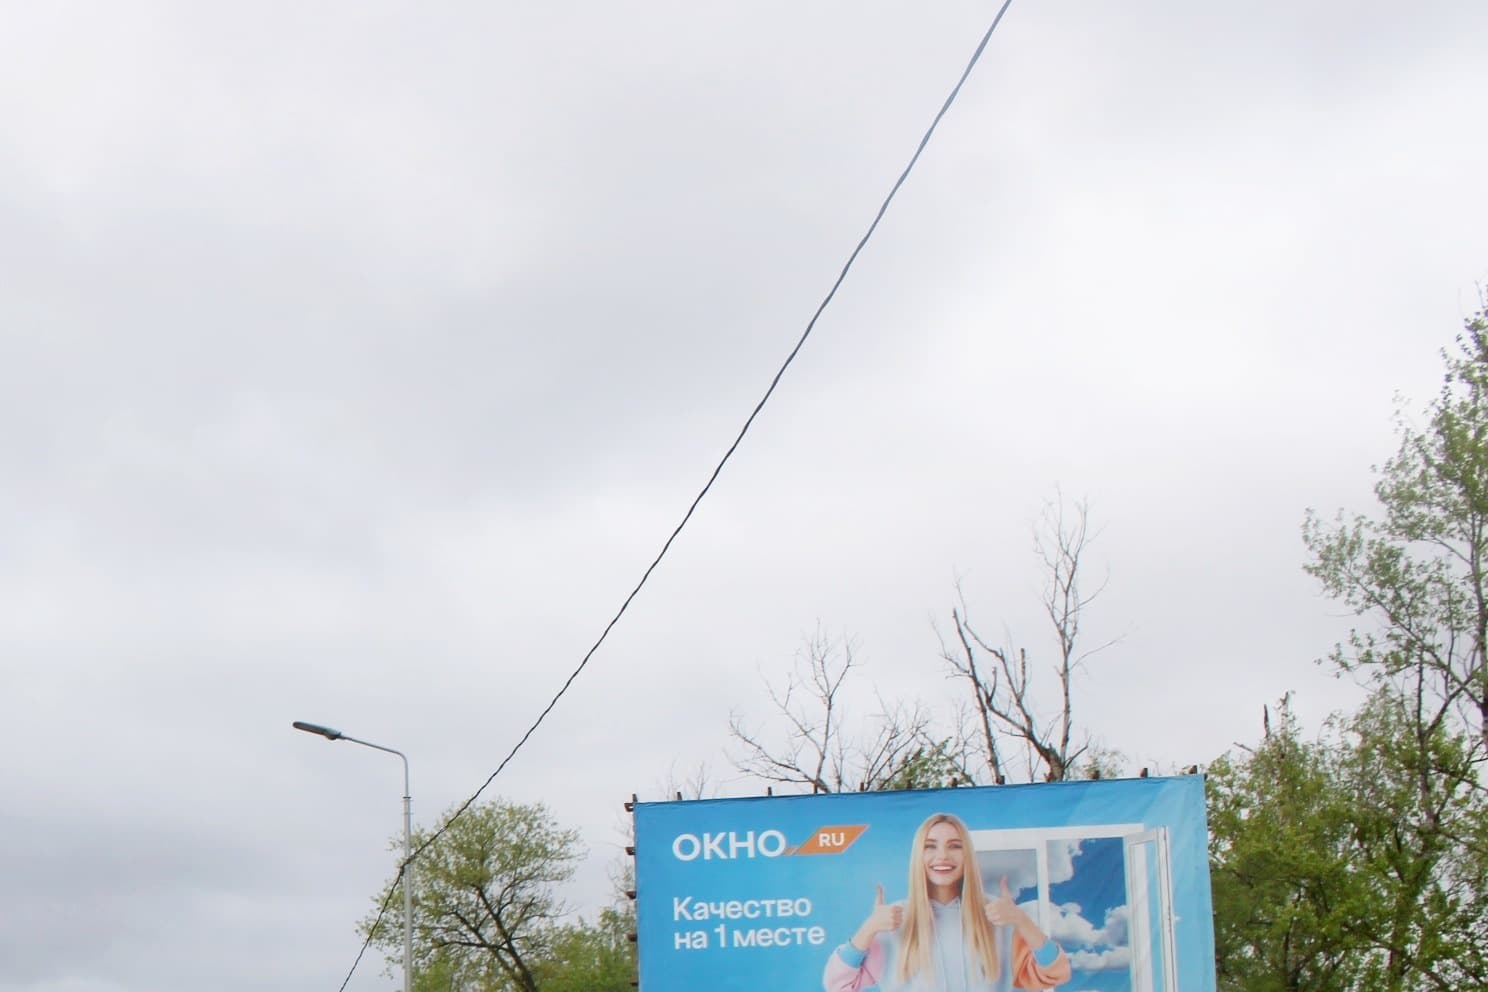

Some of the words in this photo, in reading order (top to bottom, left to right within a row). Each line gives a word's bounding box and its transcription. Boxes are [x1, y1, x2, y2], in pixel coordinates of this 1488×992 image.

[672, 829, 787, 862] ОКНО
[818, 832, 846, 848] RU
[673, 896, 813, 922] Качество
[674, 930, 709, 950] на
[714, 924, 727, 949] 1
[733, 926, 826, 949] месте
